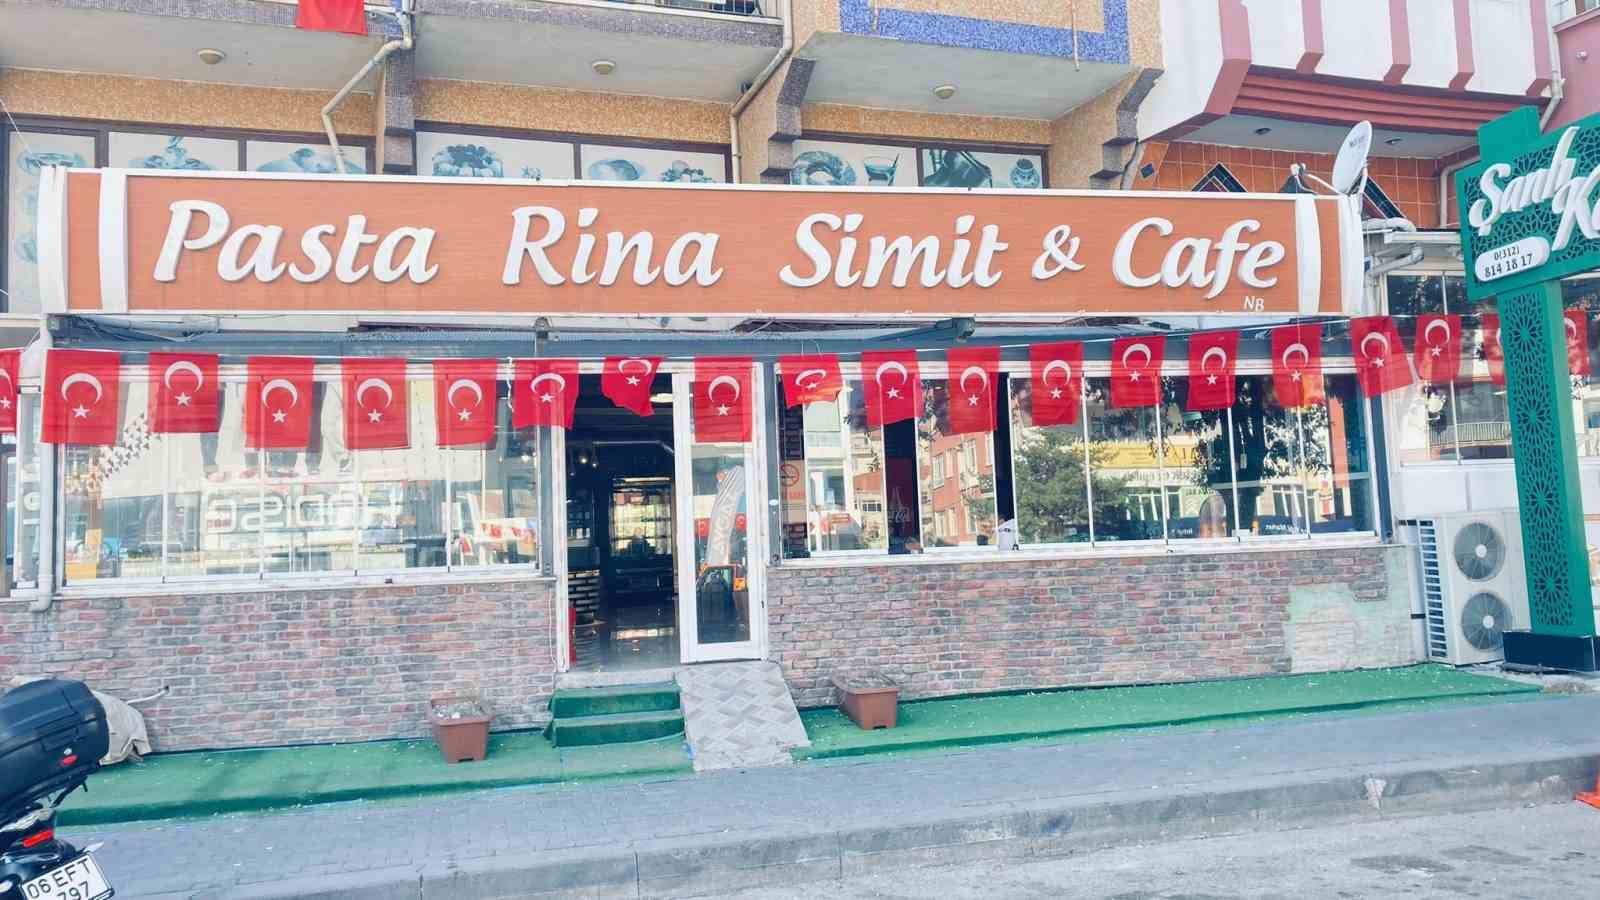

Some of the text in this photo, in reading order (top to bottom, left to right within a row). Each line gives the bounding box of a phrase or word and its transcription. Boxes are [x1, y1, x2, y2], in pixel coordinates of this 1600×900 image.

[153, 199, 1286, 299] Pasta Rina Simit & Cafe
[1484, 252, 1533, 278] 814 18 17
[27, 858, 91, 899] 06 EFT
